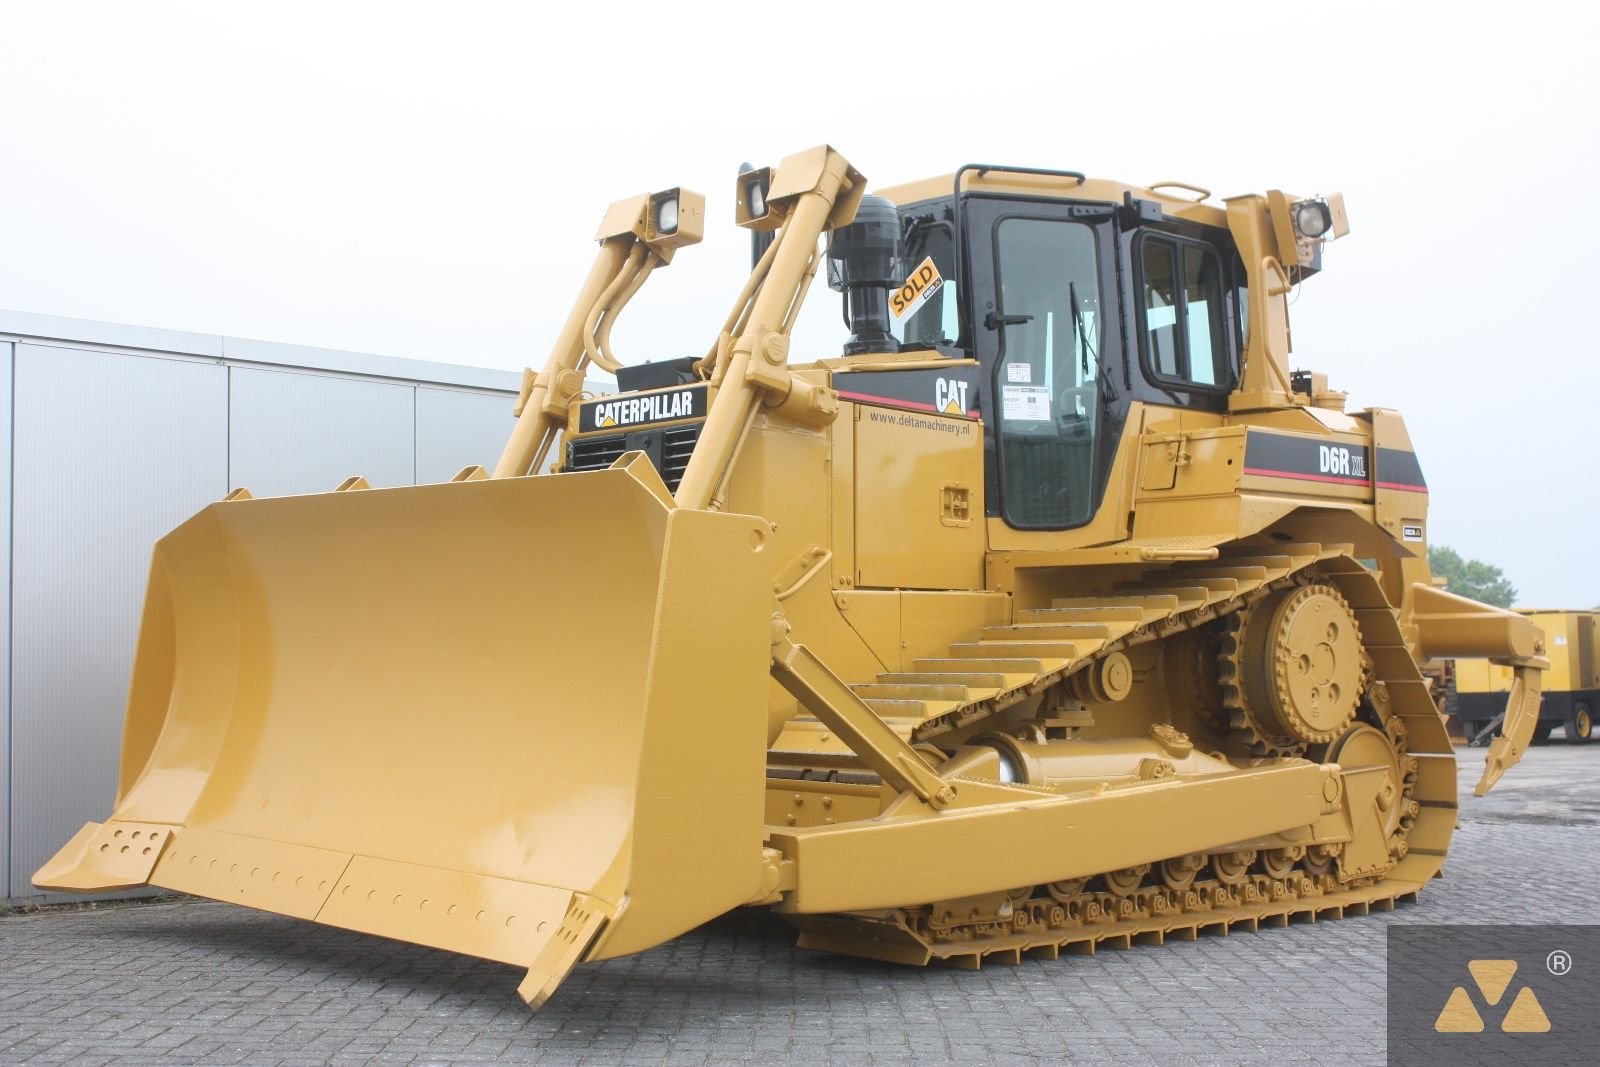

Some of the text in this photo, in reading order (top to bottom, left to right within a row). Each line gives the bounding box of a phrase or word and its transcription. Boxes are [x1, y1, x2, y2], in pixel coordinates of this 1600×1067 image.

[893, 266, 933, 312] SOLD
[594, 391, 693, 427] CATERPILLAR
[935, 377, 968, 415] CAT
[870, 412, 970, 436] www.deltamachinery.nl
[1319, 445, 1366, 477] D6R XL
